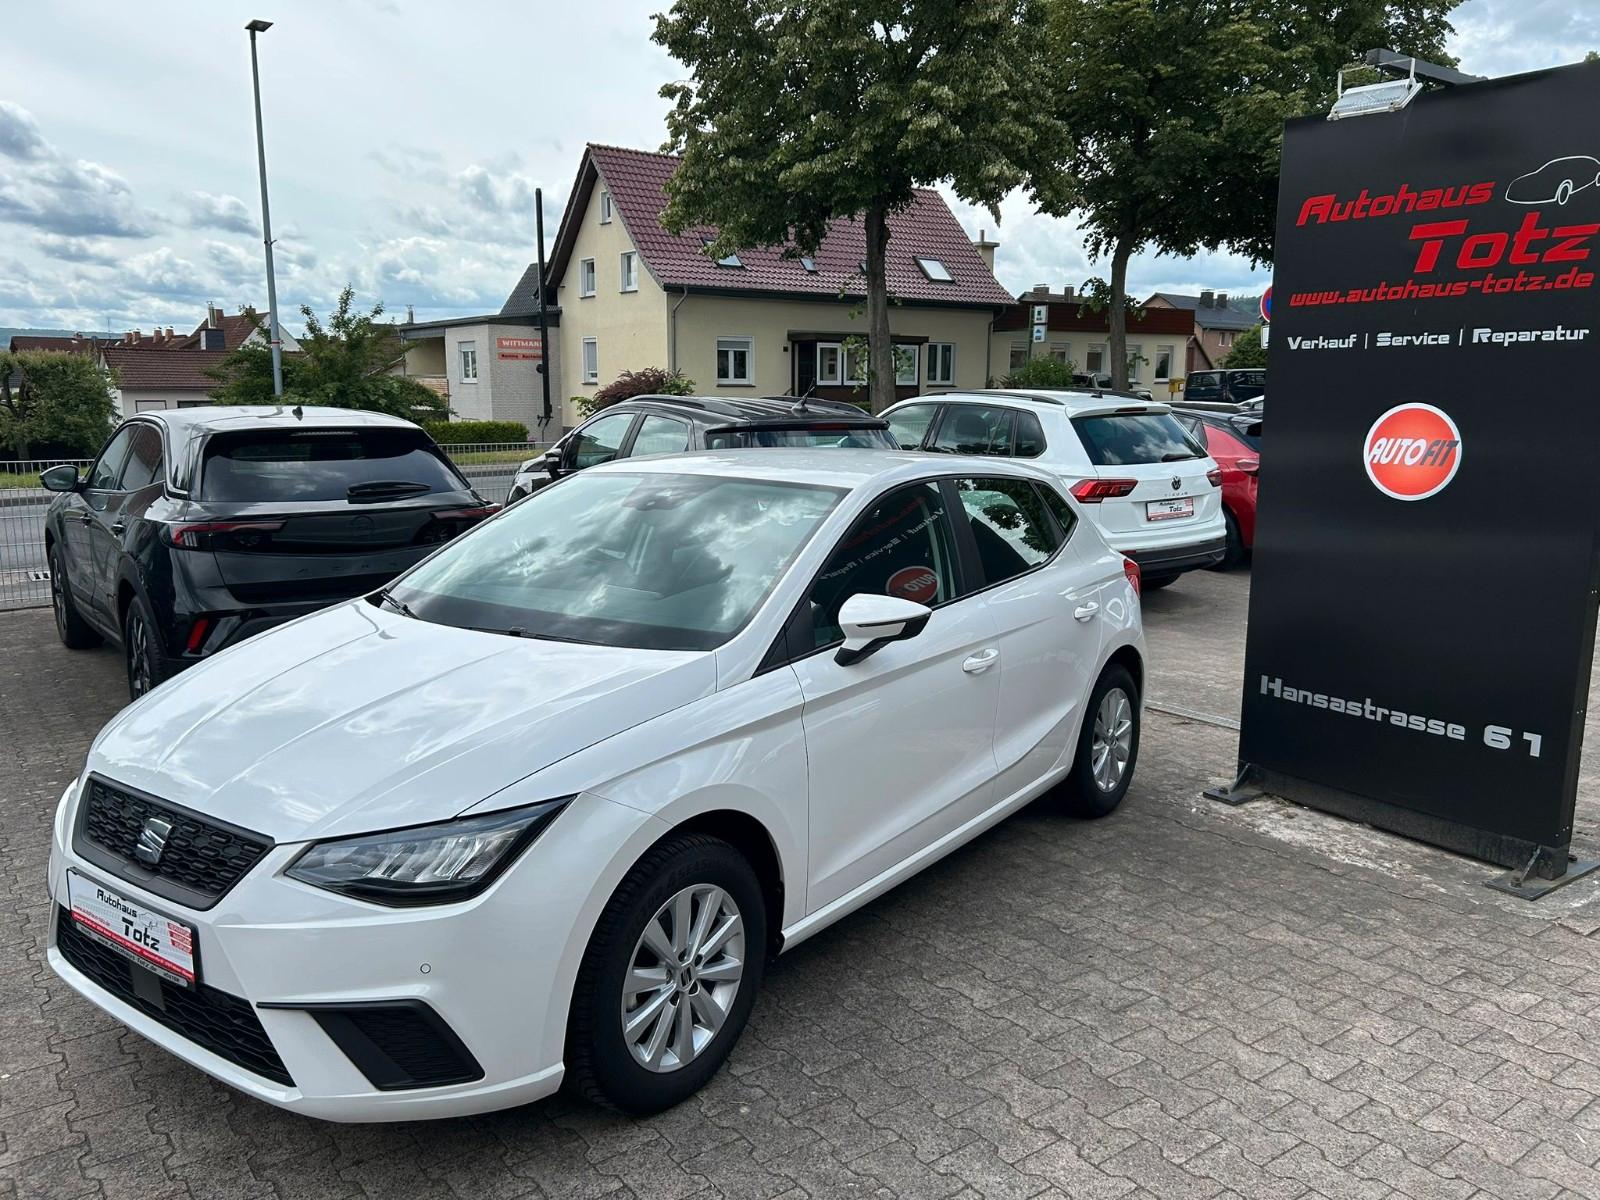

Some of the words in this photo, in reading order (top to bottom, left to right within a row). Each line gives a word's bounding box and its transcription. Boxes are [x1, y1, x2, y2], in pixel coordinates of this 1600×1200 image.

[1296, 181, 1496, 226] Autohaus
[1408, 211, 1600, 273] Totz
[1288, 266, 1595, 306] www.autohaus-totz.de
[1287, 334, 1357, 350] Verkauf
[1376, 331, 1450, 347] Service
[1472, 324, 1590, 347] Reparatur
[1368, 437, 1460, 466] AUTOFIT
[1260, 674, 1466, 741] Hansastrasse
[1483, 724, 1543, 758] 61
[96, 888, 137, 918] Autohaus
[121, 916, 160, 951] Totz
